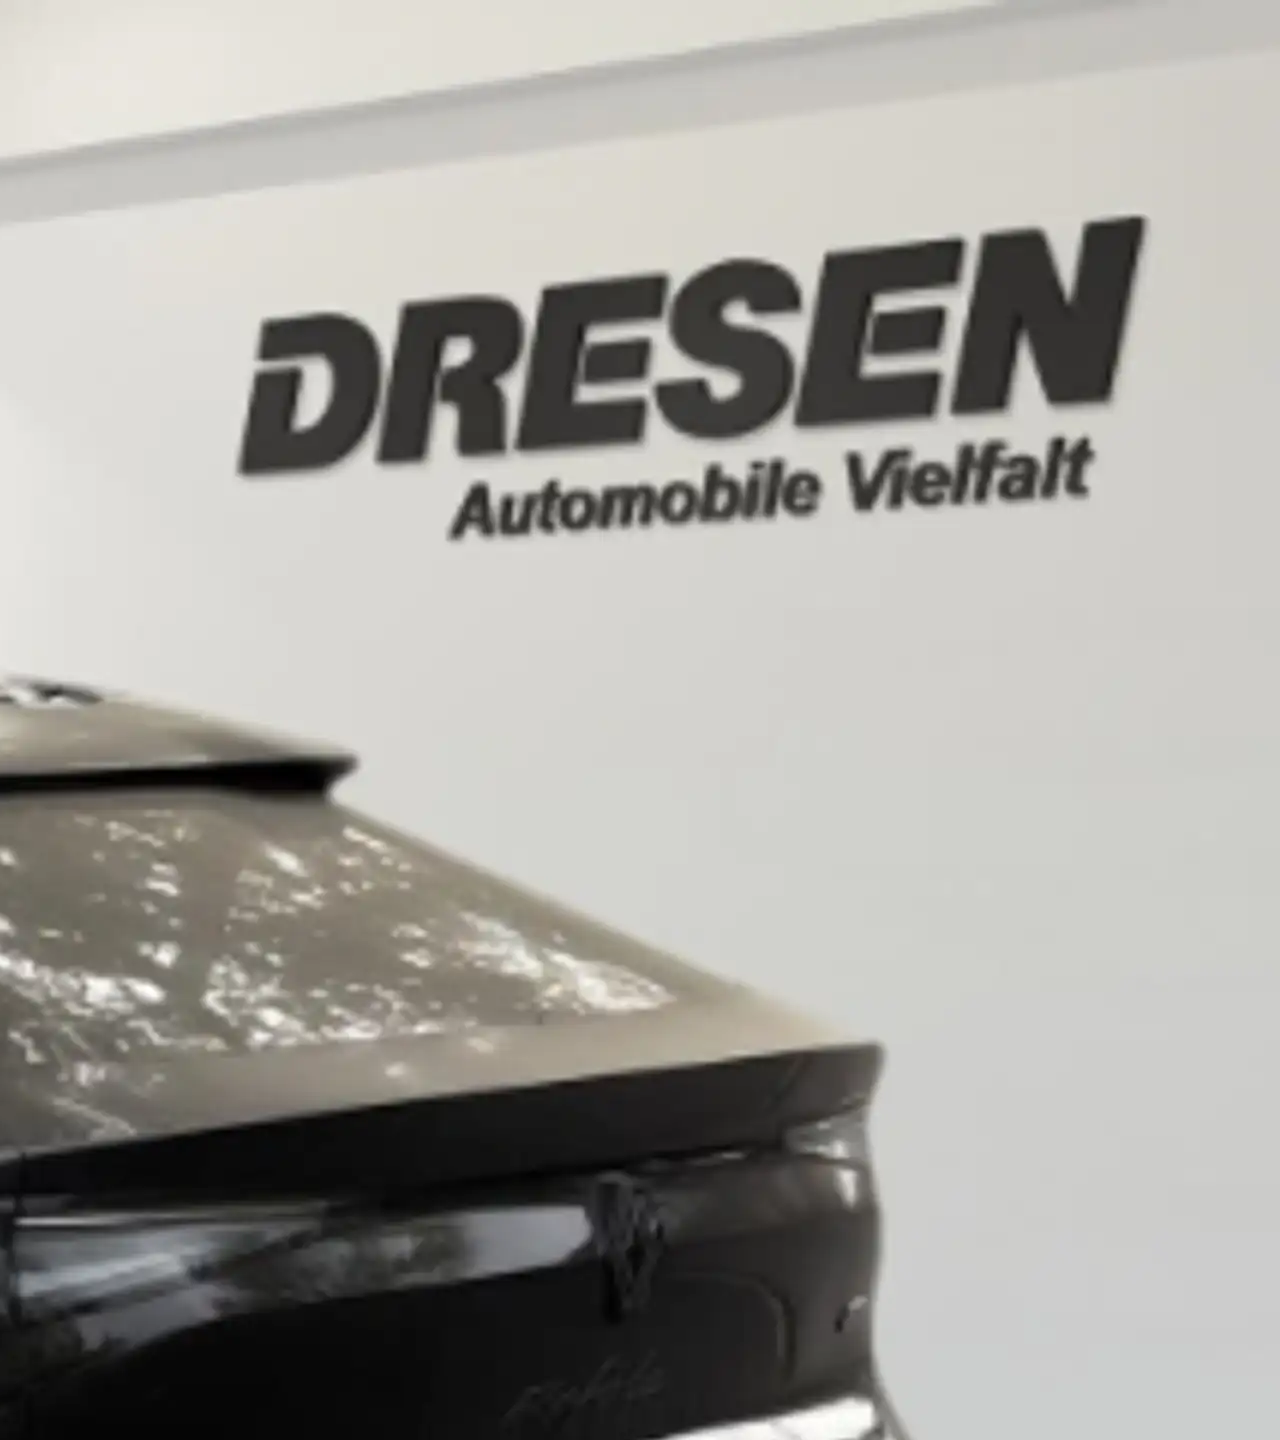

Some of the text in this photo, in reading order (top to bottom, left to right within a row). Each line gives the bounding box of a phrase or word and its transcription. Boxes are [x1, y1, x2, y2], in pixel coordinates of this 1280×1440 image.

[238, 216, 1145, 476] DRESEN
[449, 435, 1095, 540] Automobile Vielfalt
